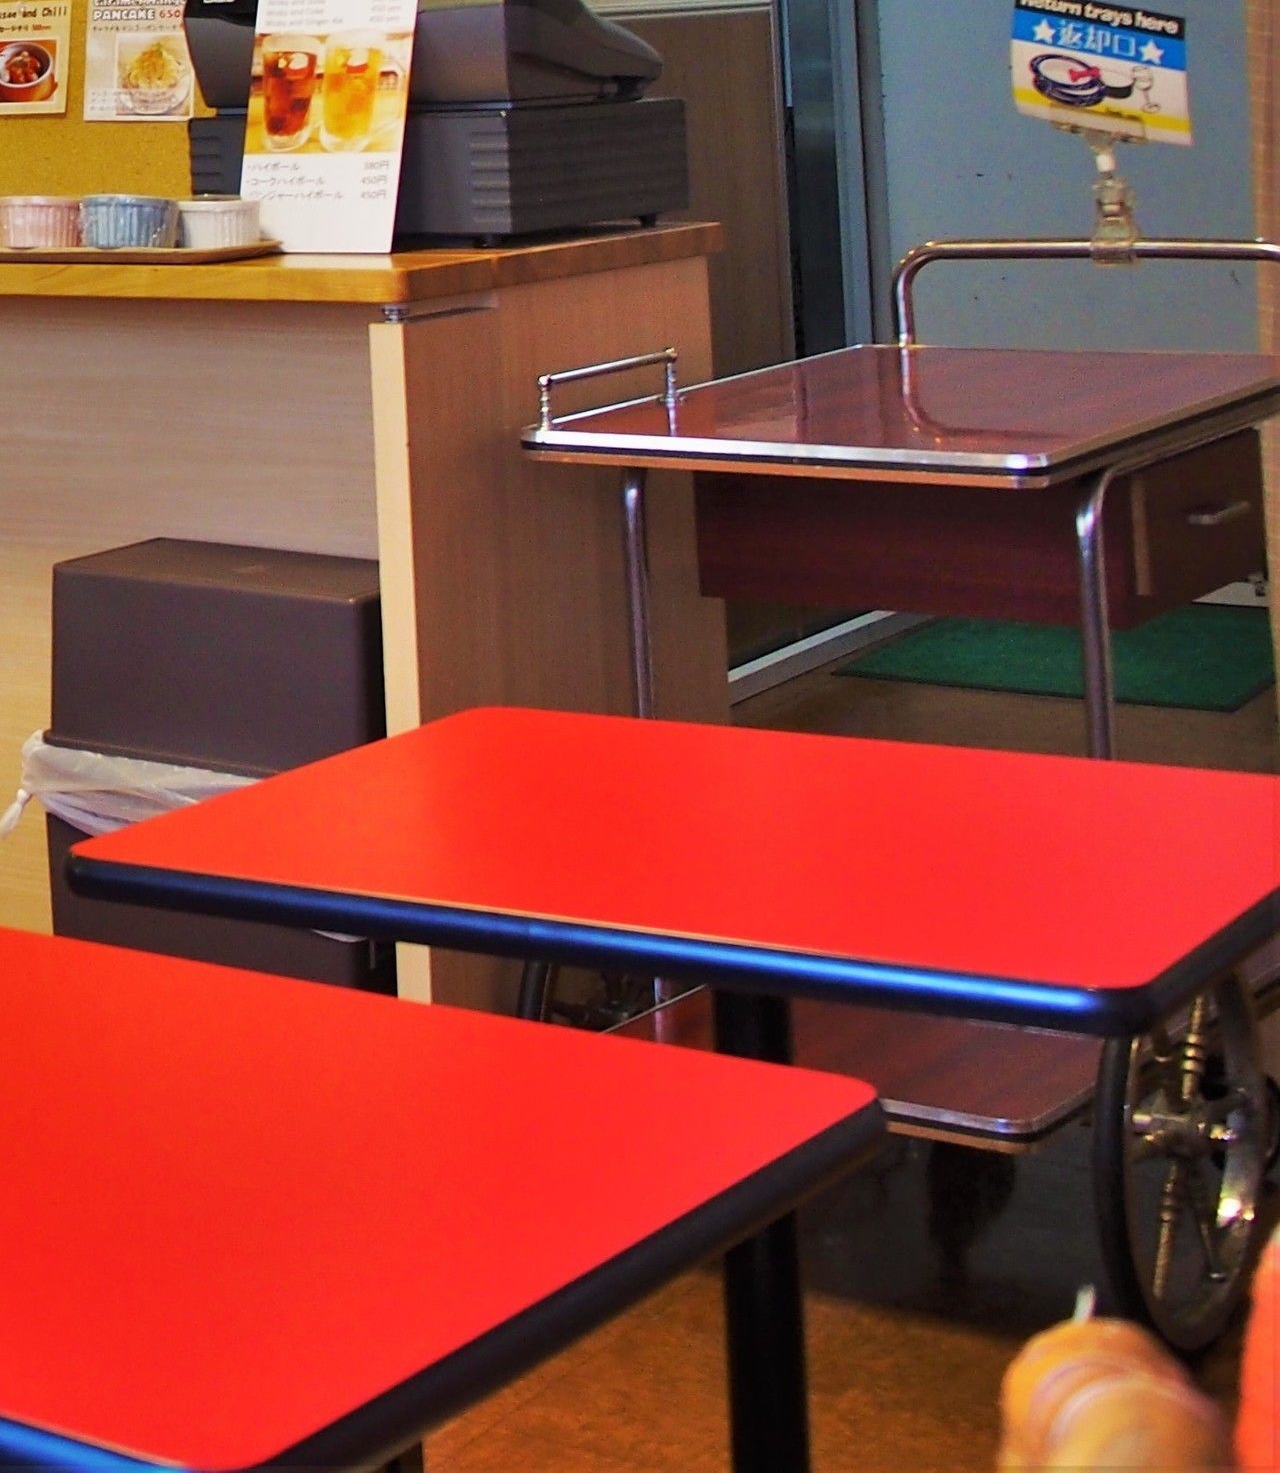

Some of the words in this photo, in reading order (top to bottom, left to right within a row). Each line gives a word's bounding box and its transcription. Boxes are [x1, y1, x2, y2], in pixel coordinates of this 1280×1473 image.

[93, 8, 155, 21] PANCAKE
[1084, 3, 1133, 27] trays
[1135, 12, 1178, 35] here
